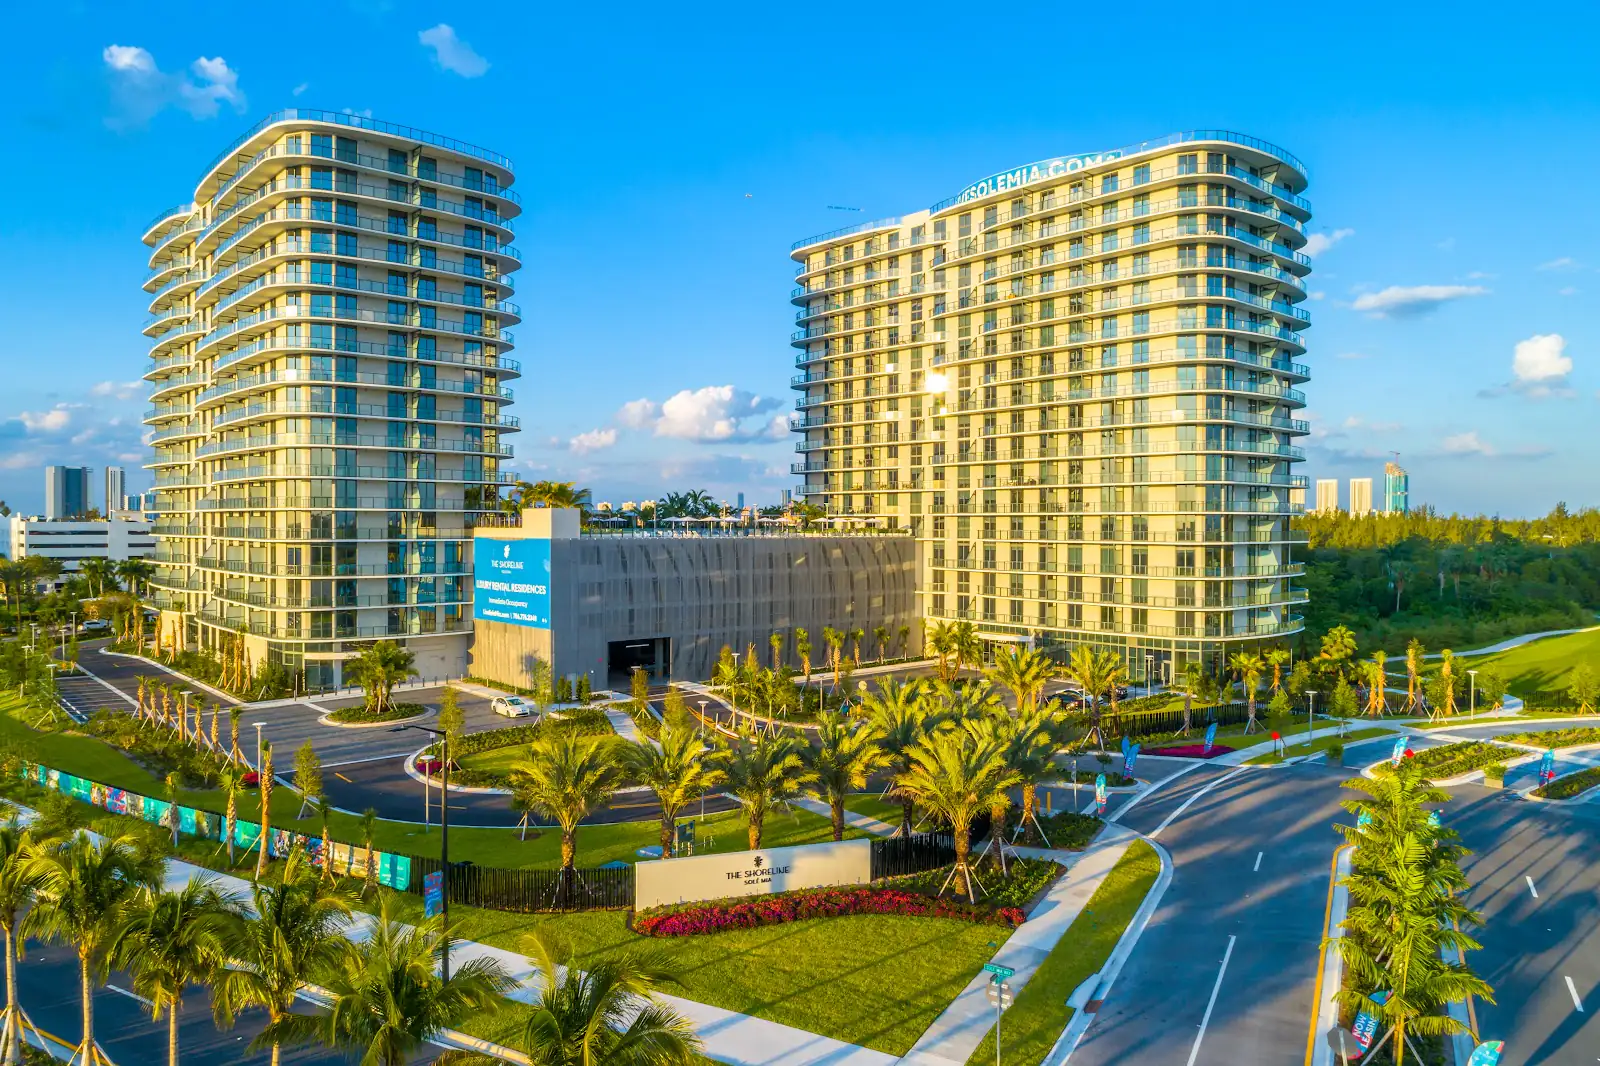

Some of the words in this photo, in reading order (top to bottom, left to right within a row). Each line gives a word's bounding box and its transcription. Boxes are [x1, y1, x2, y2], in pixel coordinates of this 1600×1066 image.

[491, 581, 511, 591] RENTAL
[511, 584, 546, 595] RESIDENCES
[726, 871, 742, 880] THE
[744, 866, 790, 878] SHORELINE
[1352, 1014, 1367, 1037] NOW
[1361, 1017, 1377, 1048] LEASIN
